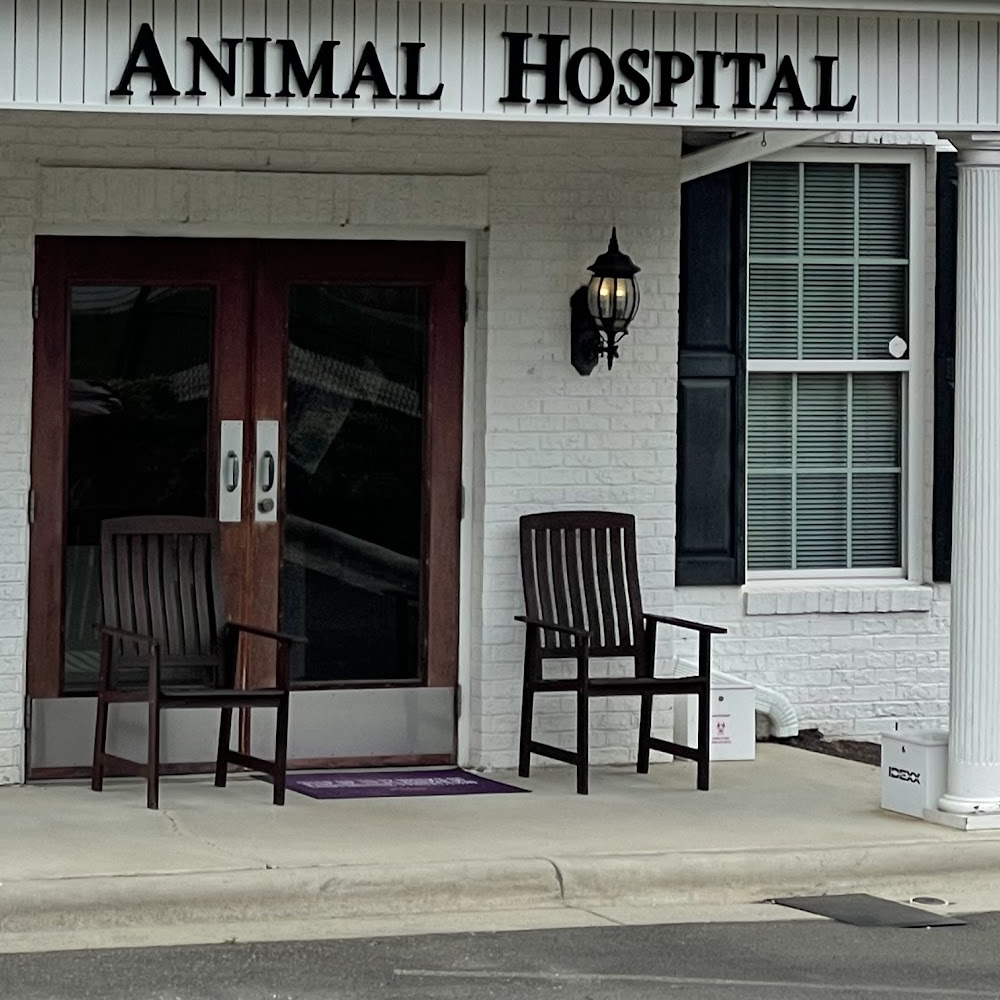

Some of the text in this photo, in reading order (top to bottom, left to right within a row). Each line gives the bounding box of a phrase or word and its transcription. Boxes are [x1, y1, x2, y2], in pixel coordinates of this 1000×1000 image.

[109, 22, 858, 112] ANIMAL HOSPITAL
[888, 765, 921, 786] IDEXX
